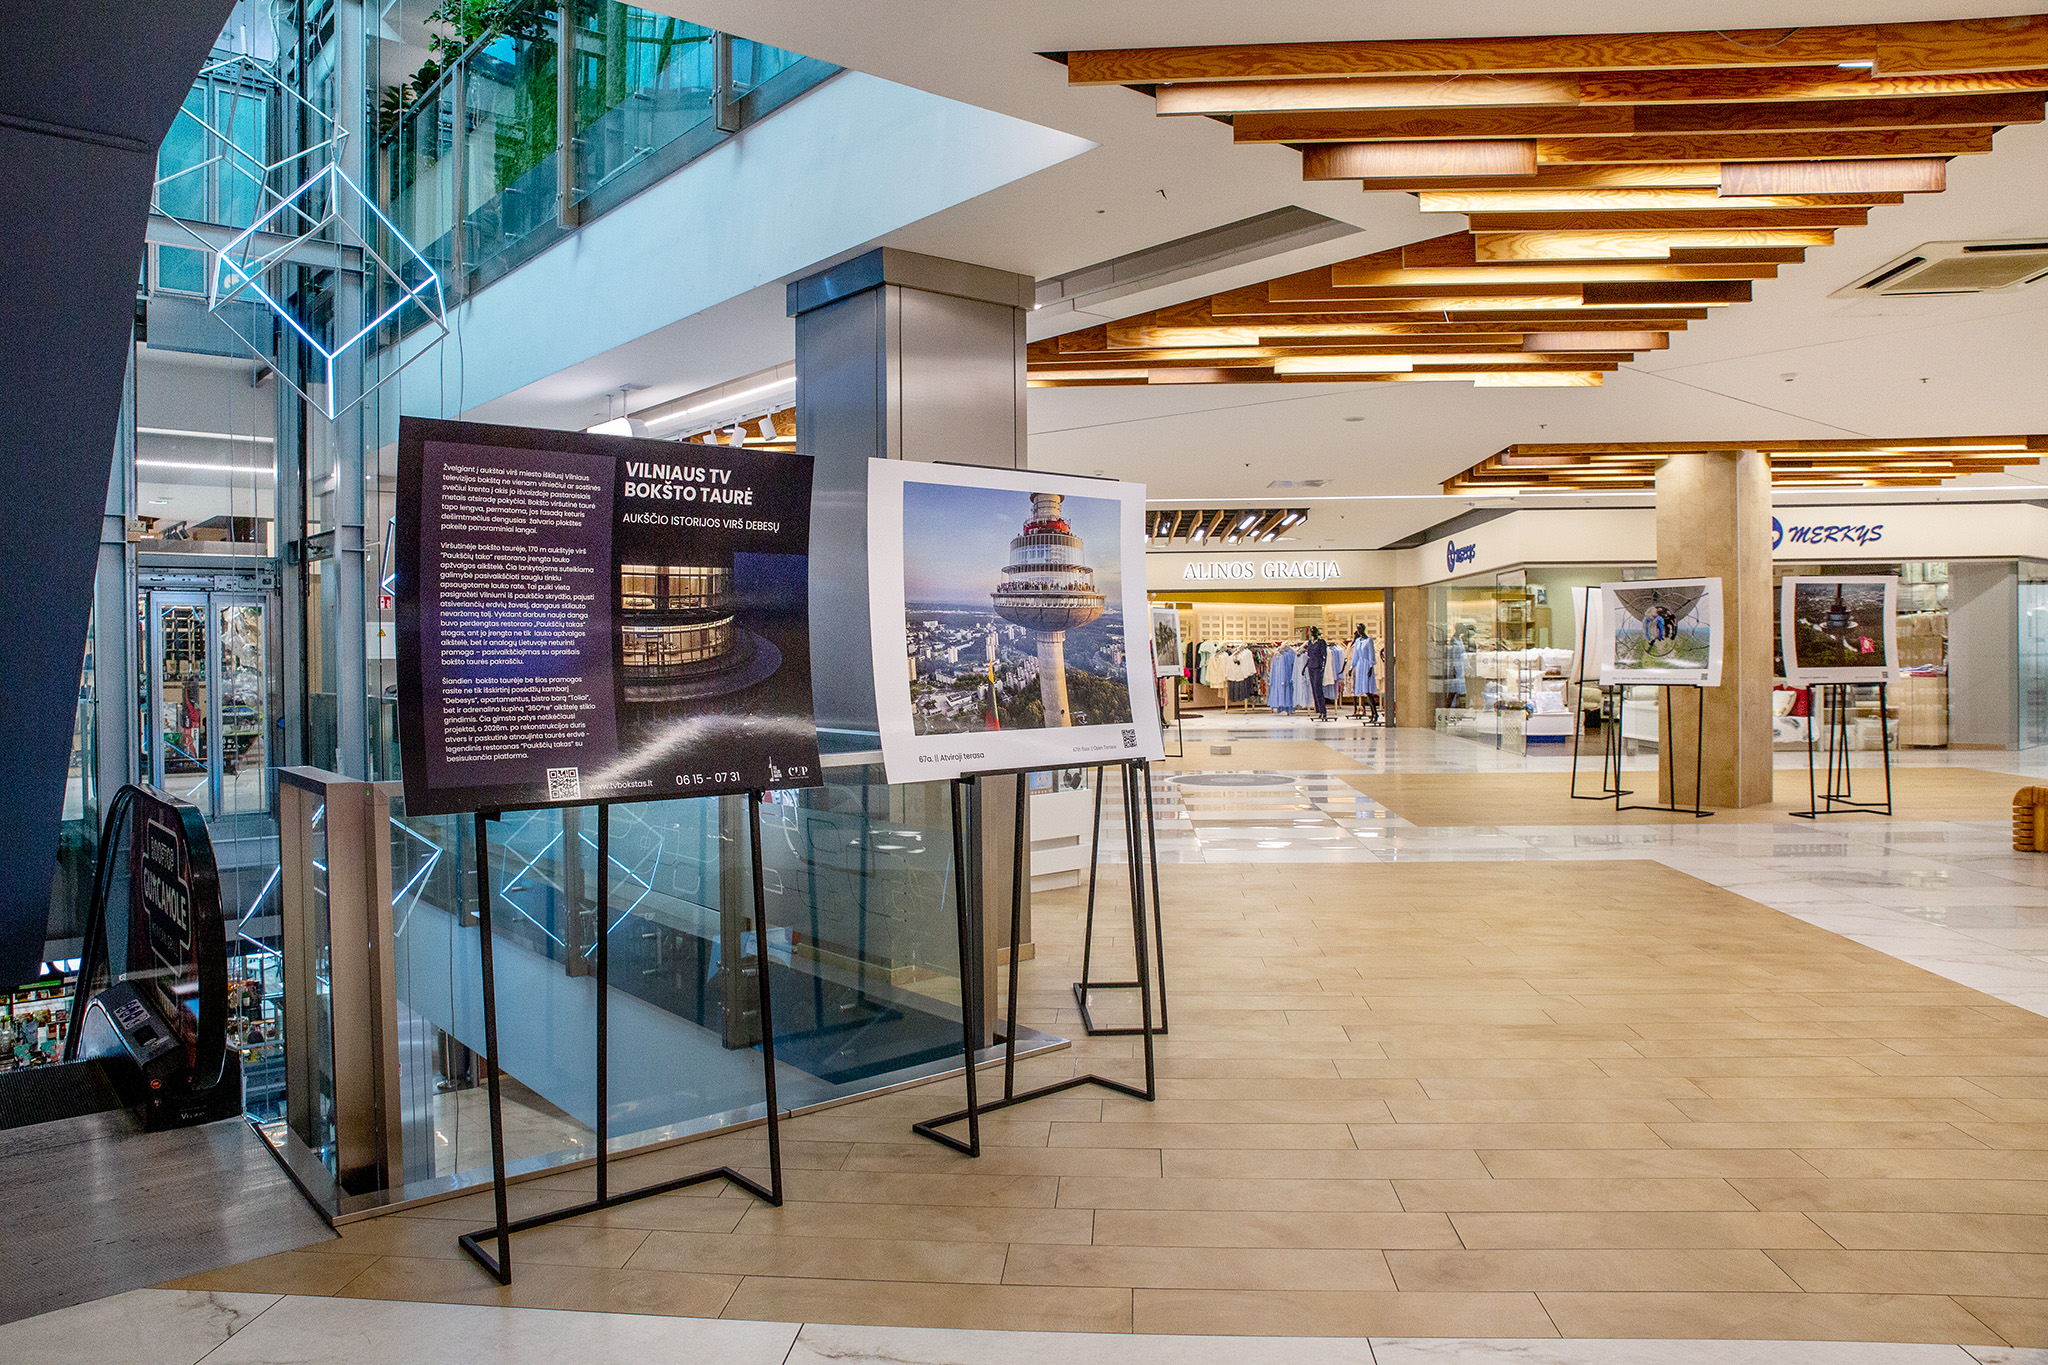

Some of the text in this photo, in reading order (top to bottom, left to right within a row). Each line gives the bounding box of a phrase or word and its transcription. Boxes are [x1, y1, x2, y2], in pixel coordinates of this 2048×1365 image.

[625, 461, 732, 484] VILNIAUS TV
[624, 481, 753, 505] BOKŠTO TAURĖ
[622, 512, 780, 533] AUKŠČIO ISTORIJOS VIRŠ DEBESŲ
[1788, 525, 1884, 546] MERKYS
[1184, 561, 1341, 581] ALINOS GRACIJA
[918, 755, 934, 763] 67a.
[940, 753, 963, 762] Atviroji
[963, 752, 985, 760] terasa
[589, 779, 653, 790] www.tvbokstas.lt
[676, 774, 691, 785] 06
[692, 773, 703, 785] 15
[714, 772, 728, 783] 07
[729, 771, 741, 782] 31
